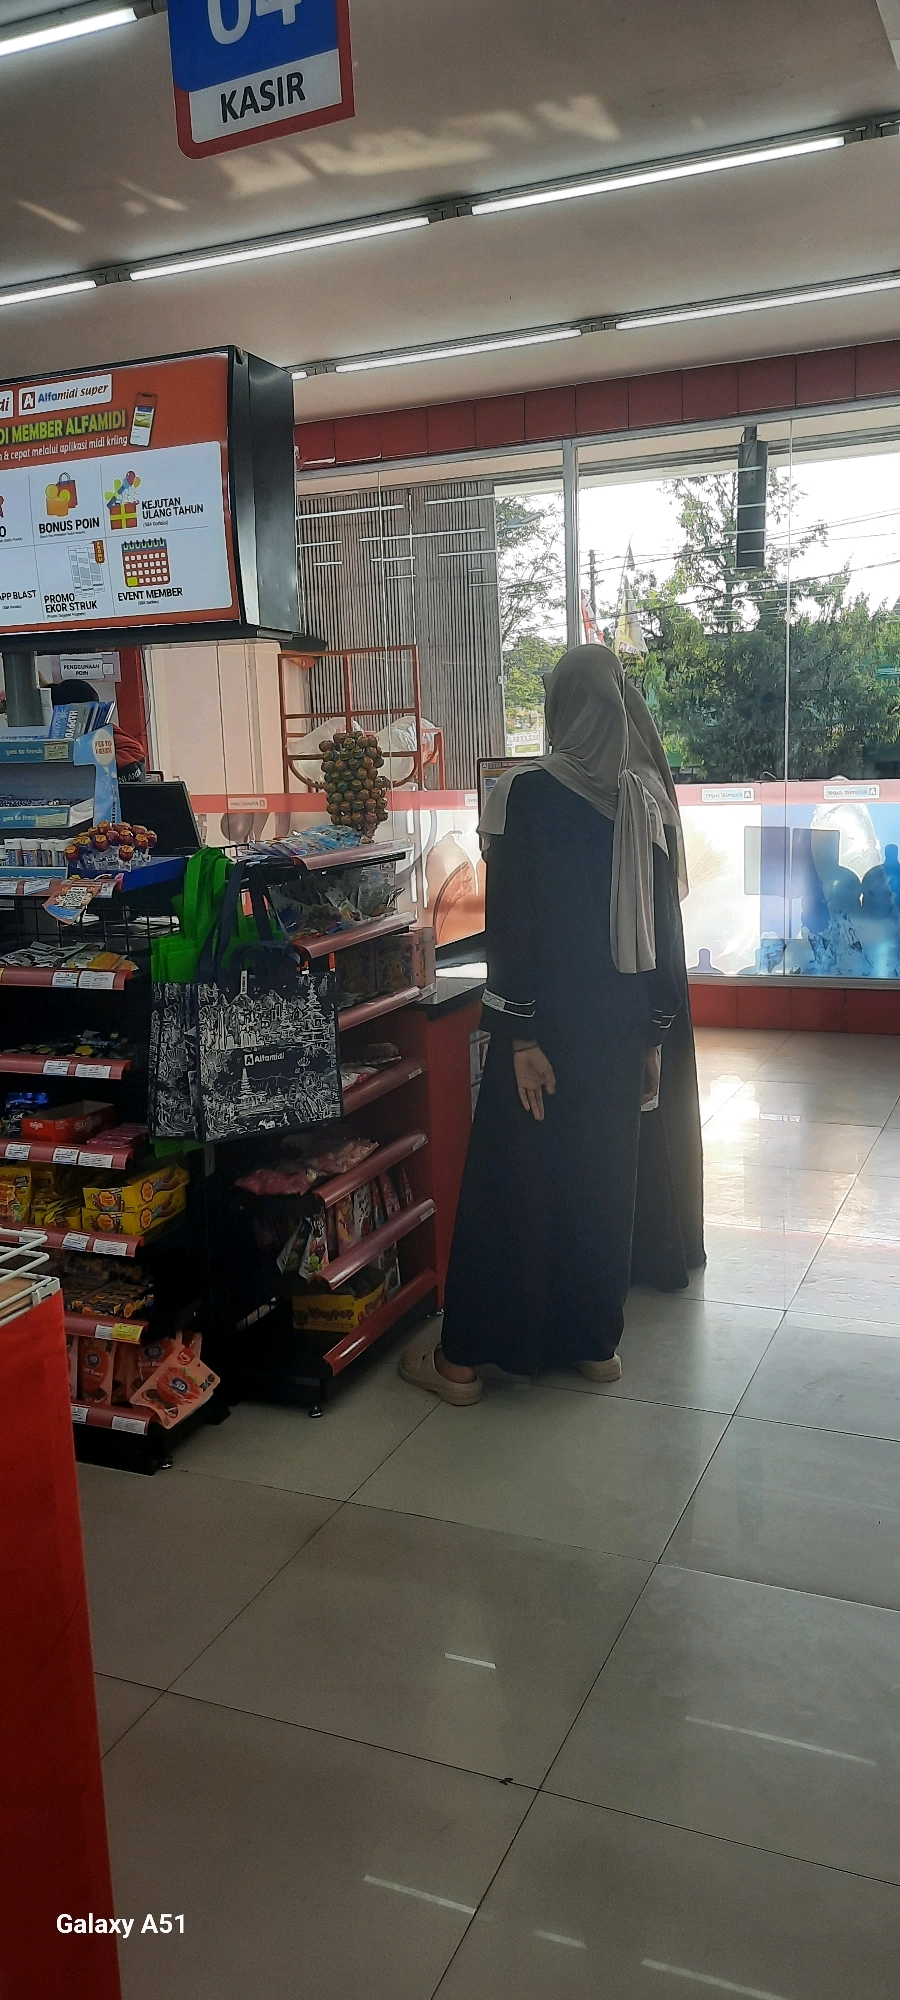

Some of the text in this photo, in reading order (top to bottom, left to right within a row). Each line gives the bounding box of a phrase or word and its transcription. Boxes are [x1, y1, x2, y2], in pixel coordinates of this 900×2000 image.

[220, 71, 306, 124] KASIR
[37, 387, 78, 403] Alfamidi
[80, 383, 109, 397] super
[12, 419, 63, 443] MEMBER
[65, 409, 126, 436] ALFAMIDI
[10, 448, 30, 462] cepat
[31, 445, 59, 457] melalui
[59, 439, 87, 455] aplikasi
[88, 436, 105, 449] midi
[142, 496, 181, 510] KEJUTAN
[142, 503, 204, 520] ULANG TAHUN
[38, 516, 100, 534] BONUS POIN
[12, 589, 37, 600] BLAST
[44, 592, 75, 604] PROMO
[117, 587, 183, 602] EVENT MEMBER
[45, 600, 98, 614] EKOR STRUK
[254, 1051, 285, 1063] Alfamidi
